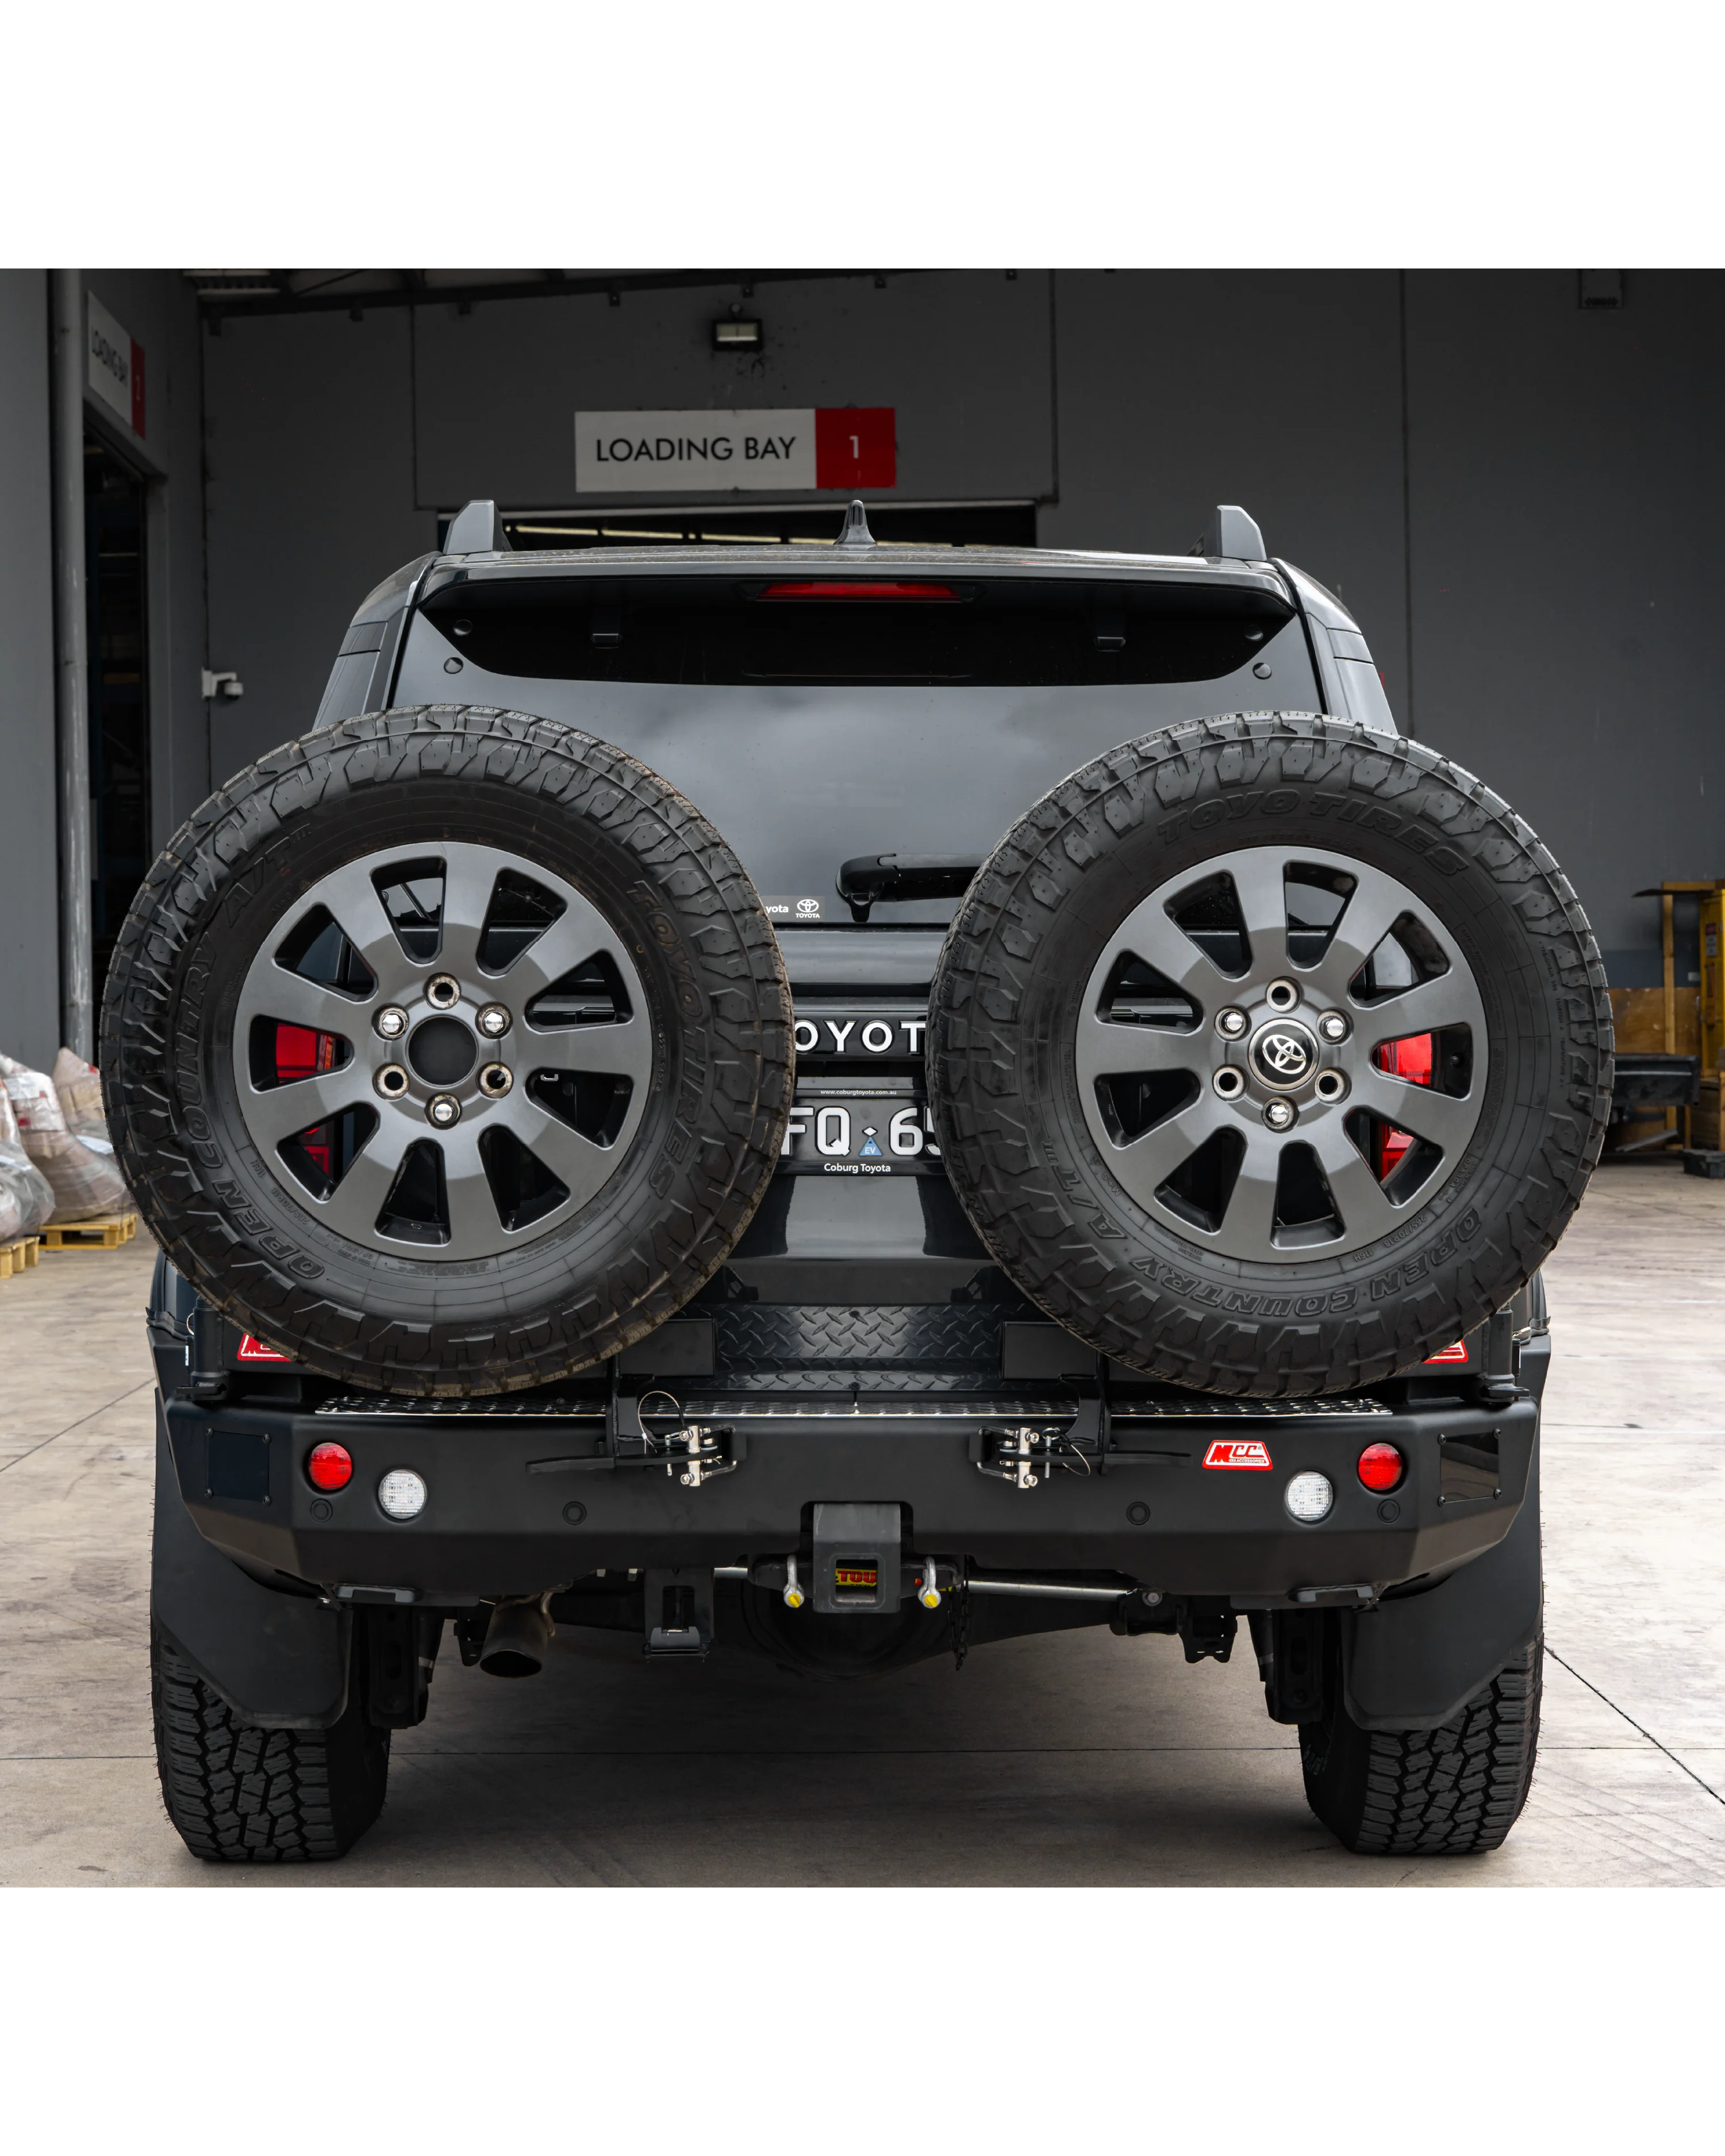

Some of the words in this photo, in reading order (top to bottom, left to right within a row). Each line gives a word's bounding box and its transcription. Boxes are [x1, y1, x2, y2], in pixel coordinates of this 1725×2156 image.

[597, 438, 733, 461] LOADING
[744, 437, 796, 459] BAY
[849, 435, 859, 459] 1
[1158, 790, 1298, 844] TOYO
[1311, 791, 1469, 878] TIRES
[628, 880, 704, 1016] TOYO
[176, 931, 226, 1165] COUNTRY
[795, 1019, 926, 1053] OYOT
[646, 1027, 707, 1199] TIRES
[824, 1163, 858, 1173] Coburg
[860, 1163, 891, 1173] Toyota
[1455, 1179, 1467, 1193] JAPAN
[269, 1186, 310, 1227] 265/70R18
[1051, 1167, 1127, 1237] A/T
[211, 1181, 324, 1279] OPEN
[1382, 1214, 1428, 1249] 265/70R18
[1353, 1248, 1373, 1263] 116H
[1372, 1208, 1481, 1301] OPEN
[1128, 1262, 1358, 1316] COUNTRY
[837, 1571, 876, 1583] TOU
